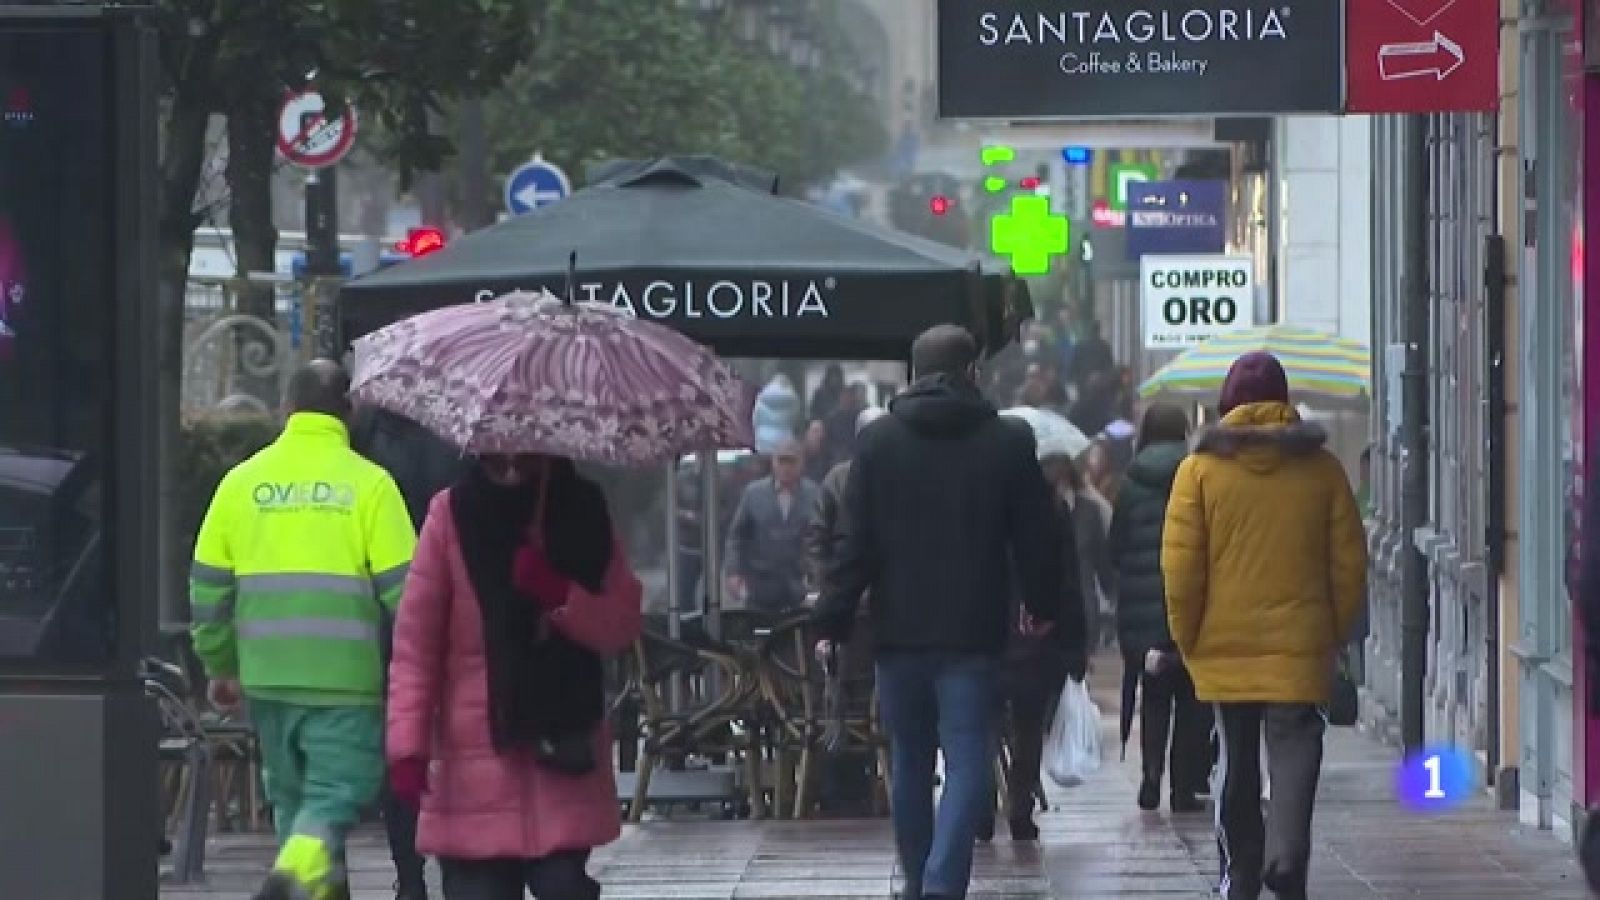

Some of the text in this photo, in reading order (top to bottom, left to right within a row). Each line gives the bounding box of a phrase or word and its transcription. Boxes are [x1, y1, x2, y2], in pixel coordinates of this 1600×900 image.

[979, 9, 1287, 45] SANTAGLORIA
[1059, 51, 1208, 75] Coffee & Bakery
[1150, 269, 1247, 288] COMPRO
[474, 279, 829, 319] TAGLORIA
[1163, 297, 1237, 325] ORO
